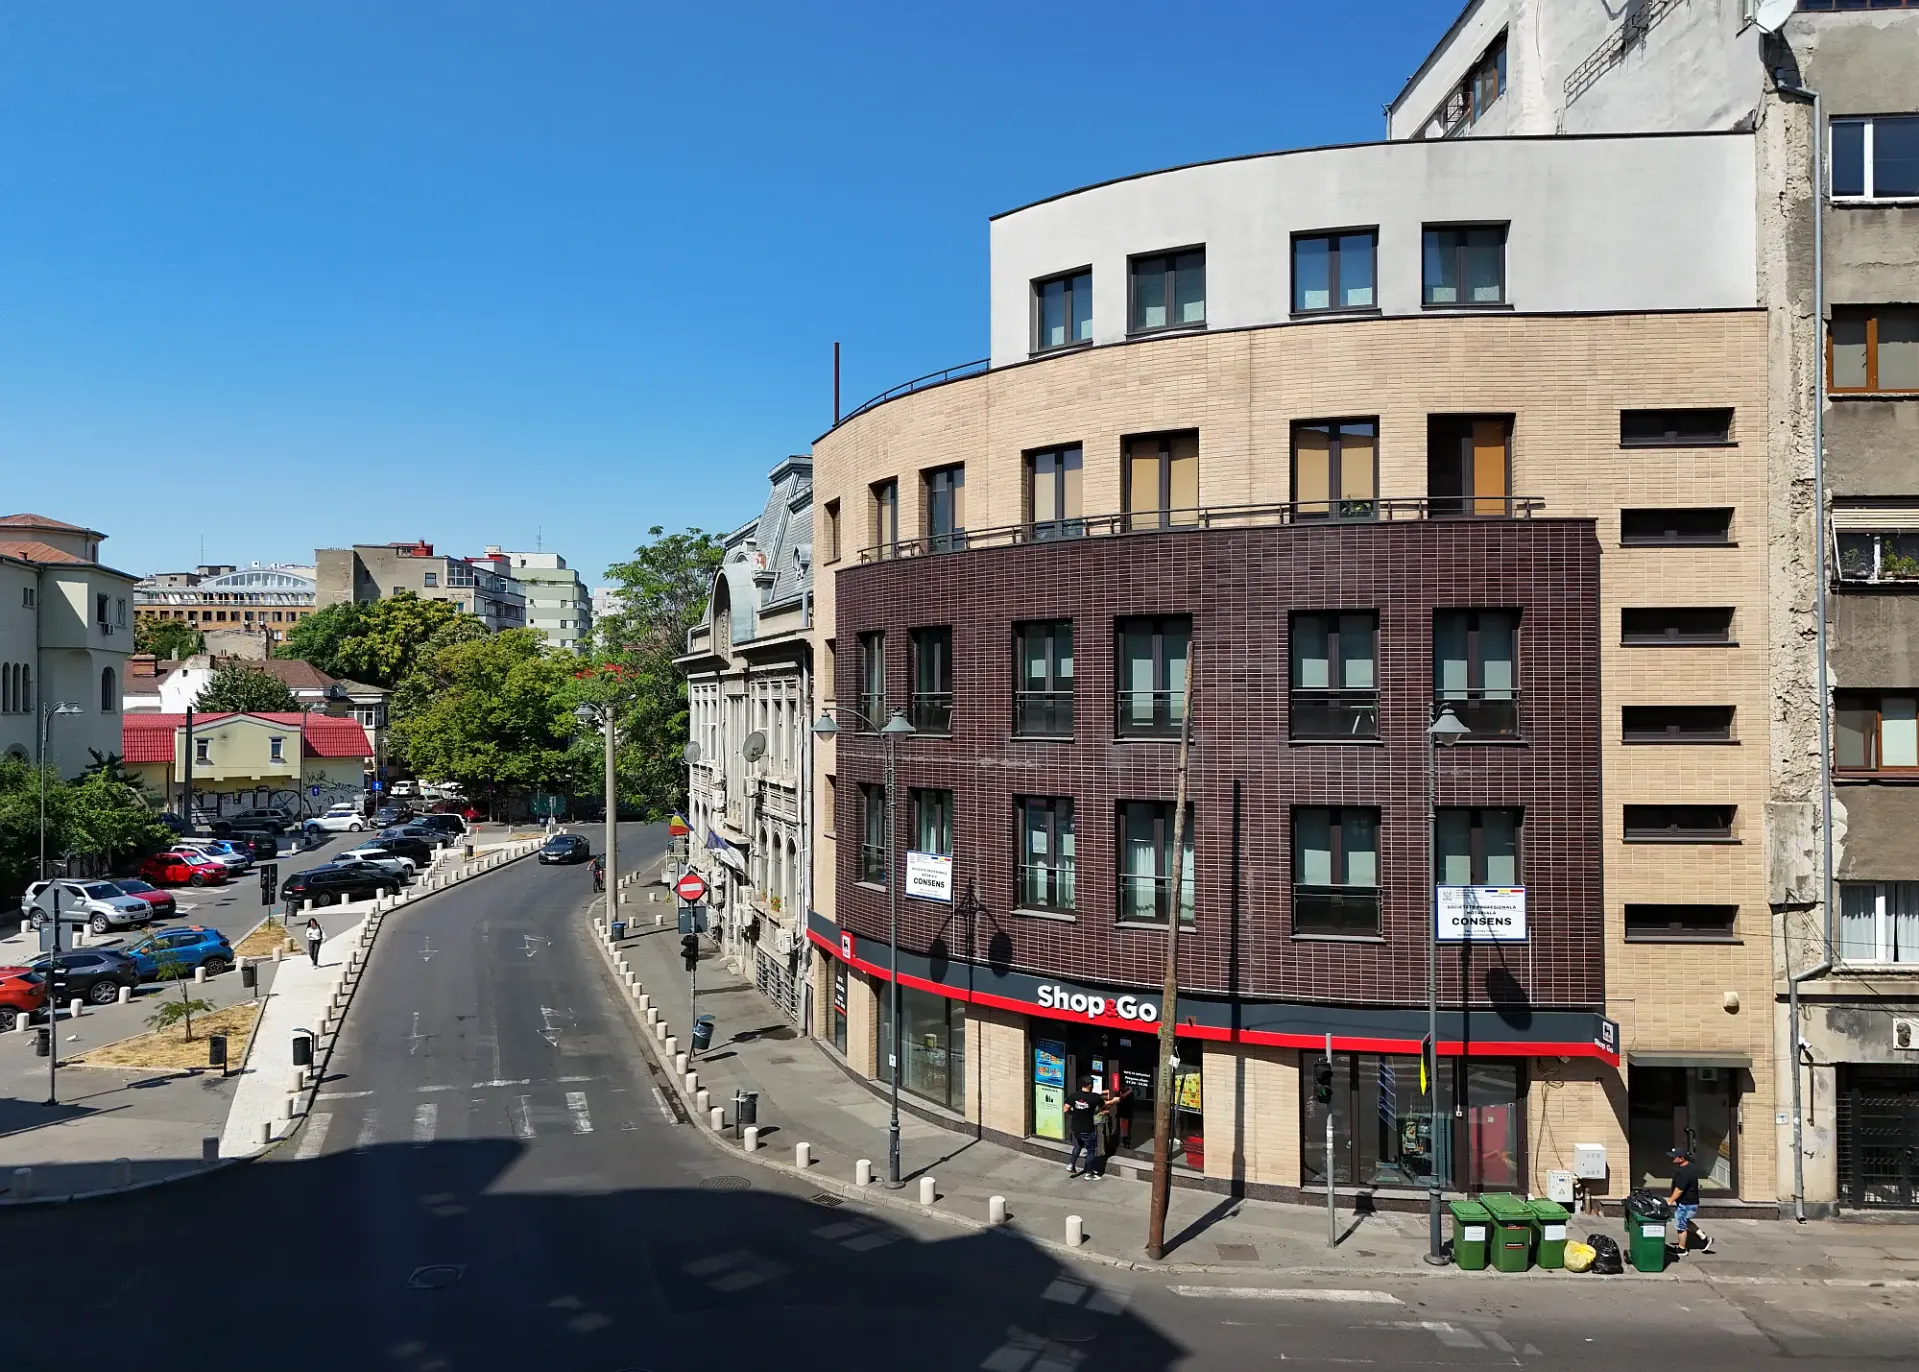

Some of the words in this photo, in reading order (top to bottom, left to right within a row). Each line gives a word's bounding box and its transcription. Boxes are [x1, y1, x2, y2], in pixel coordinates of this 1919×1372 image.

[913, 877, 945, 888] CONSENS
[1452, 917, 1512, 926] CONSENS
[1037, 984, 1158, 1022] Shop&Go
